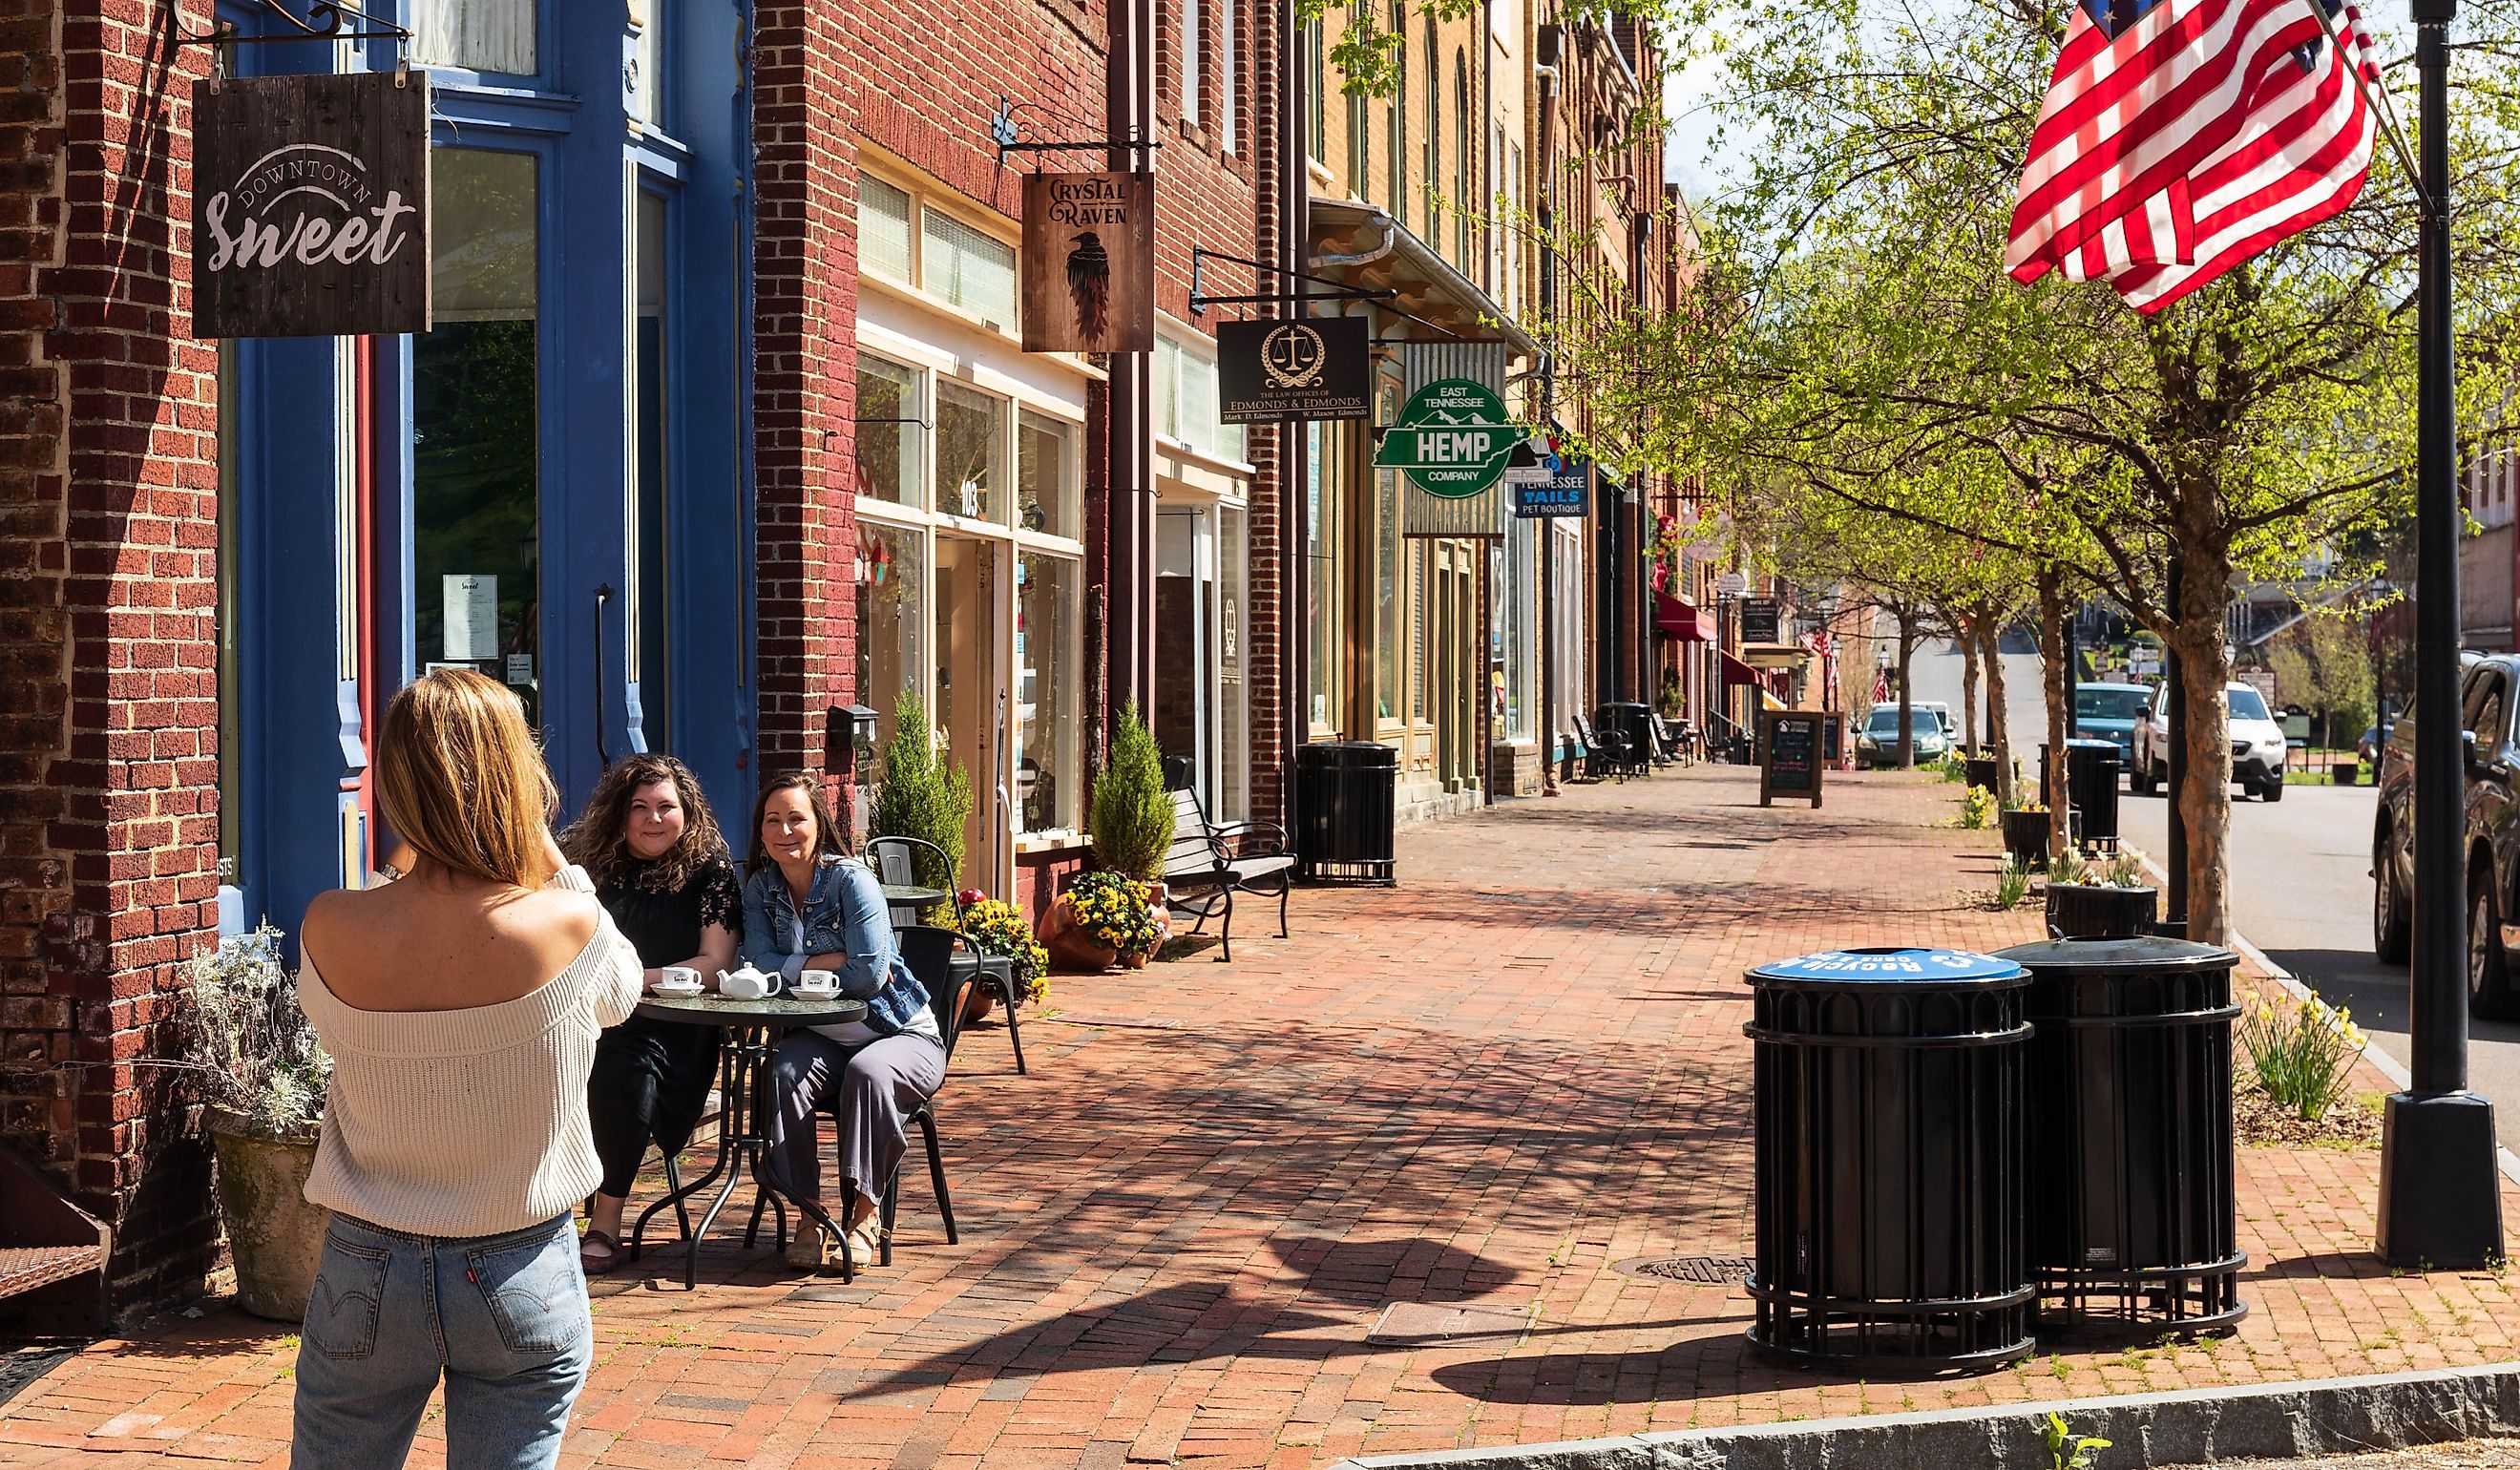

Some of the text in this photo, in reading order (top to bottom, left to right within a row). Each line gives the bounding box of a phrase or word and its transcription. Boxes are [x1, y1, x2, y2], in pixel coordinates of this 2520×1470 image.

[238, 159, 371, 209] DOWNTOWN
[1049, 178, 1126, 201] CRYSTAL
[1049, 200, 1127, 227] RAVEN
[205, 190, 417, 272] Sweet
[1439, 387, 1468, 397] EAST
[1230, 396, 1361, 411] EDMONDS & EDMONDS
[1423, 397, 1485, 409] TENNESSEE
[1224, 412, 1243, 421] Mark
[1253, 411, 1284, 420] Edmonds
[1337, 408, 1368, 417] Edmonds
[1418, 431, 1491, 462] HEMP
[1428, 471, 1480, 482] COMPANY
[960, 479, 977, 517] 103
[1524, 491, 1580, 504] TAILS
[1522, 503, 1582, 514] PET BOUTIQUE
[1801, 959, 1923, 973] Recycle
